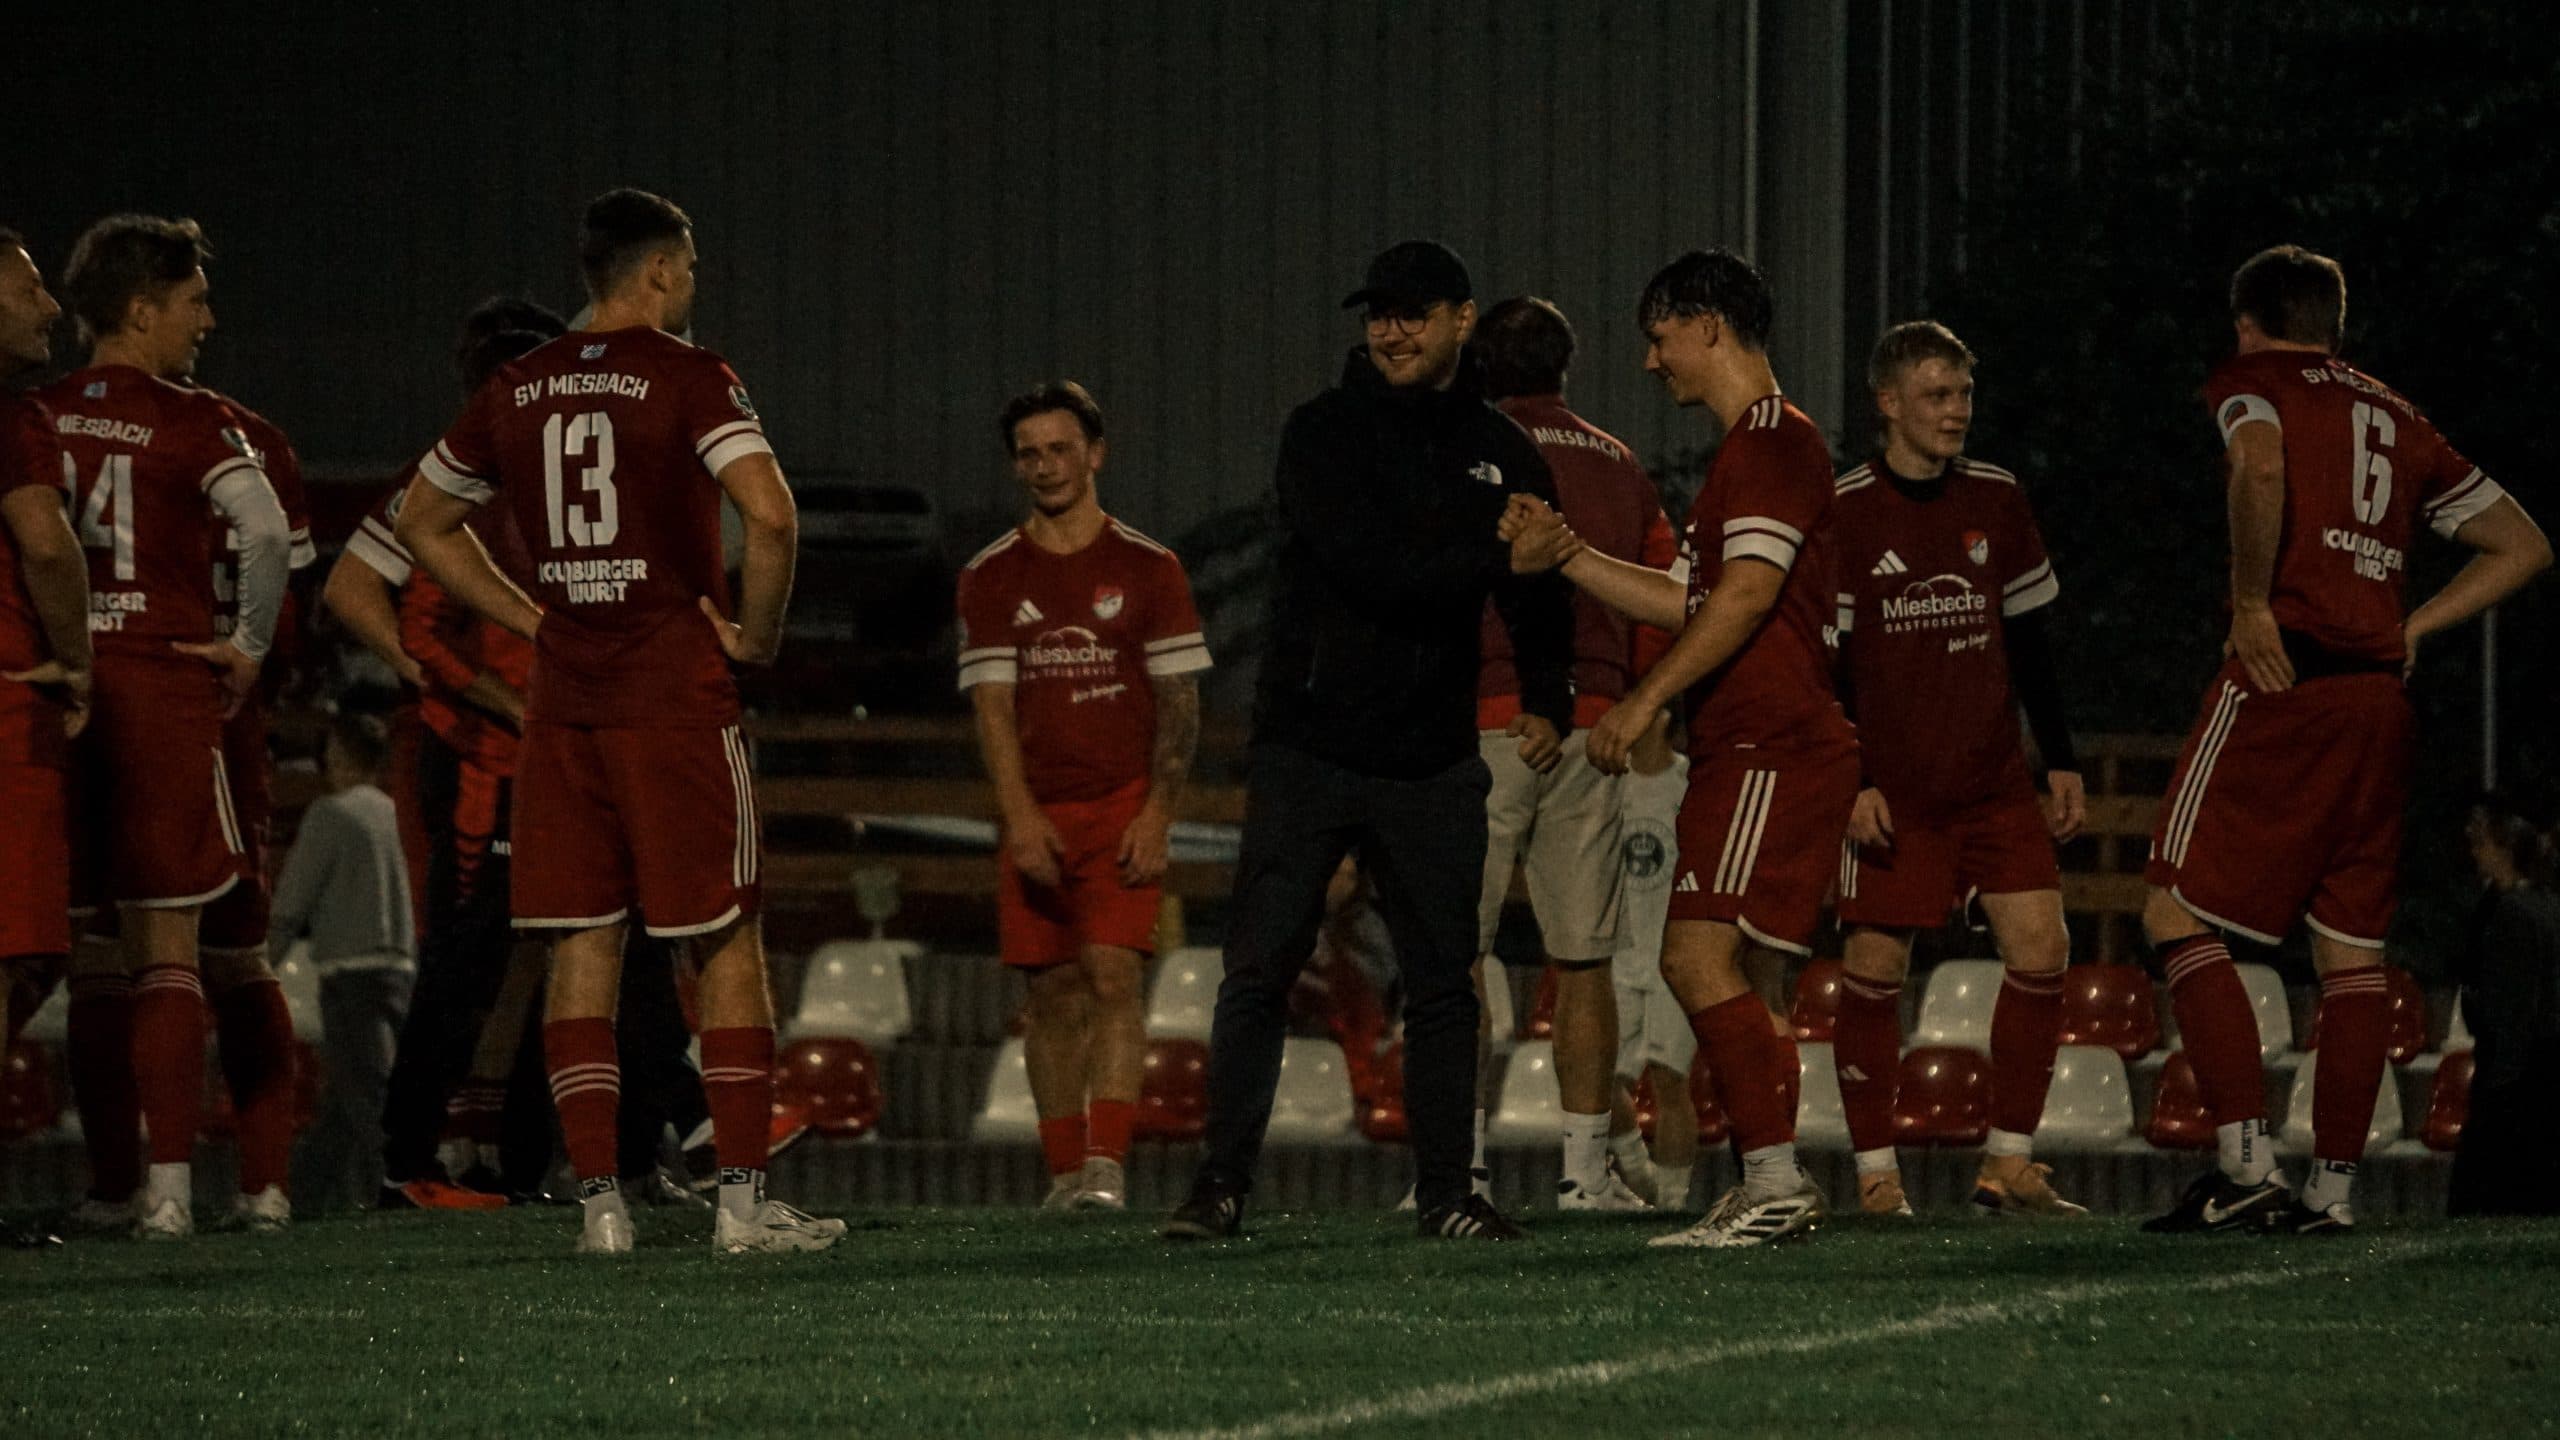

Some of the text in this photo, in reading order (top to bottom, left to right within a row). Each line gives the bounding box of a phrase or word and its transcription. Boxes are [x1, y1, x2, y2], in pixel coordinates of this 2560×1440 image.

[514, 372, 650, 408] SV MIESBACH
[2301, 367, 2331, 384] SV
[1533, 427, 1622, 462] MIESBACH
[543, 411, 619, 549] 13
[2351, 400, 2396, 526] 6
